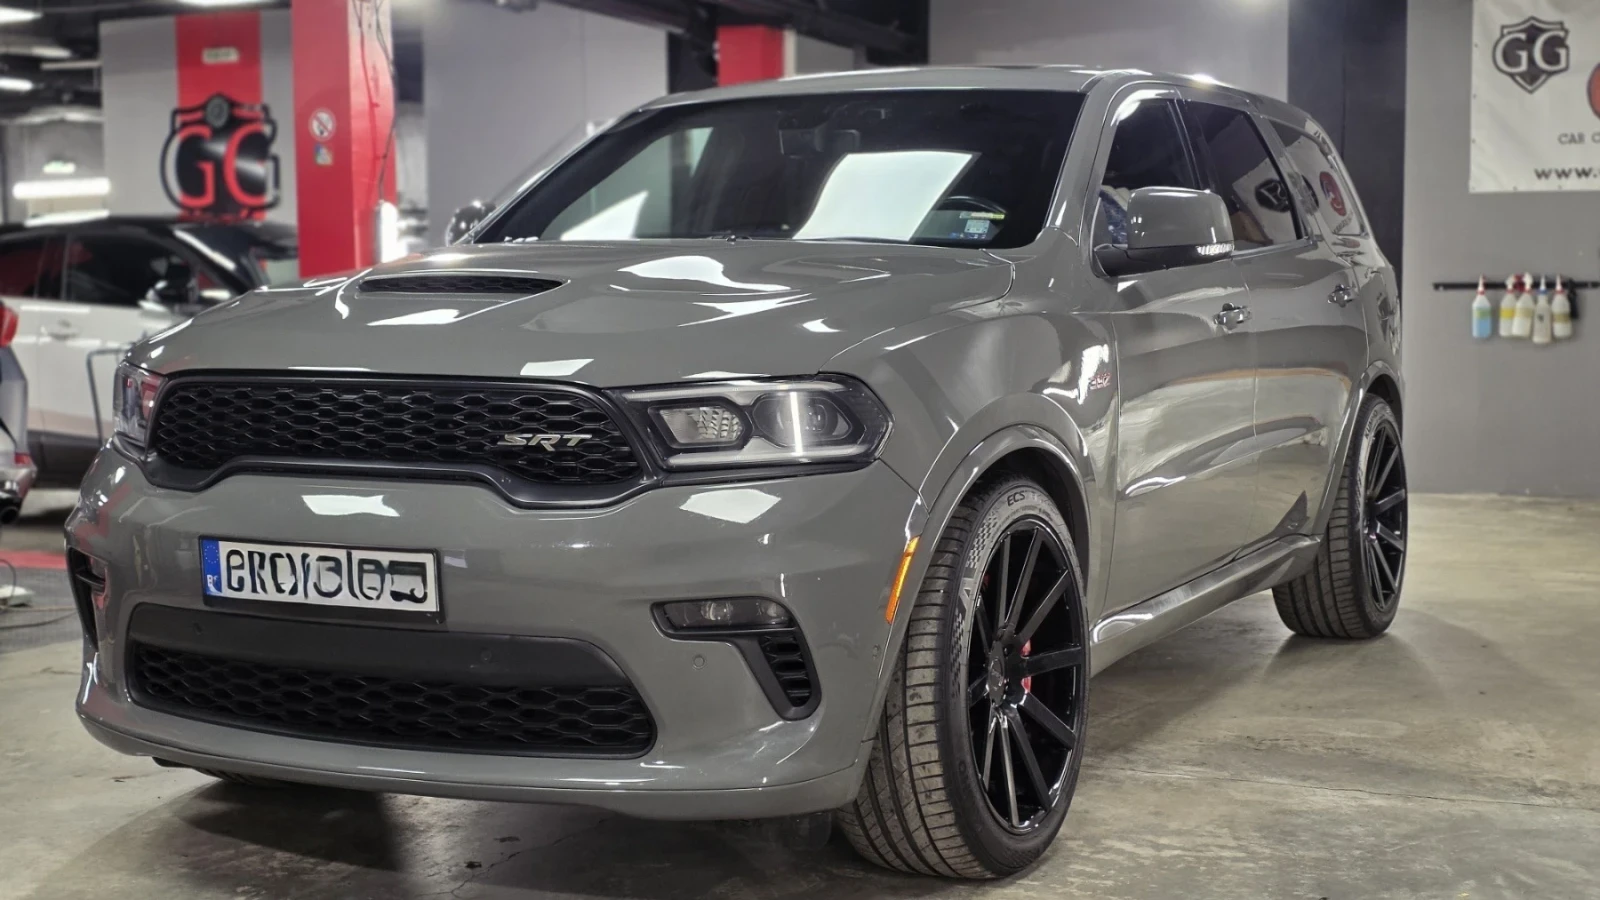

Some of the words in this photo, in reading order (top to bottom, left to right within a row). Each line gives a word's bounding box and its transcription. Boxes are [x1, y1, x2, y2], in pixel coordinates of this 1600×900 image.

[1494, 30, 1569, 74] GG
[1557, 132, 1586, 145] CAR
[1533, 166, 1600, 180] www.
[497, 433, 593, 452] SRT
[1007, 490, 1026, 507] ECS
